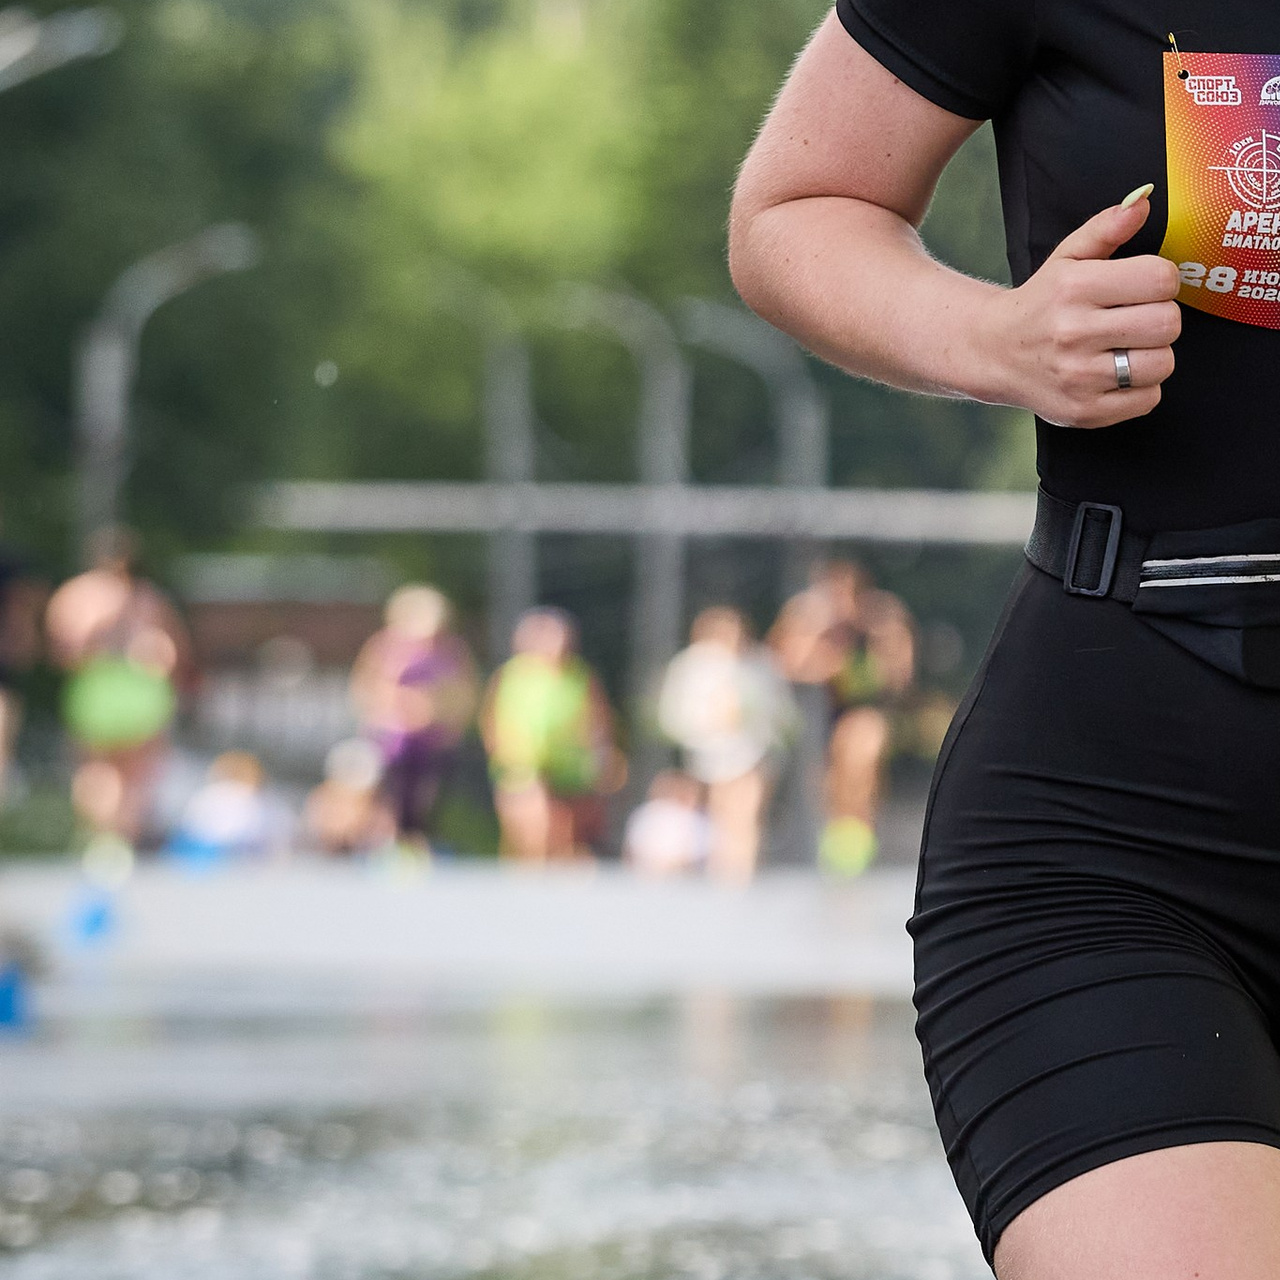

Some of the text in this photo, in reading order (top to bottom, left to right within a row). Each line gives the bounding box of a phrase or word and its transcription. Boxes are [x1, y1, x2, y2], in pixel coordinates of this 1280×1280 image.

[1188, 78, 1233, 91] СПОРТ
[1196, 90, 1239, 103] СОЮЗ
[1178, 261, 1238, 293] 28
